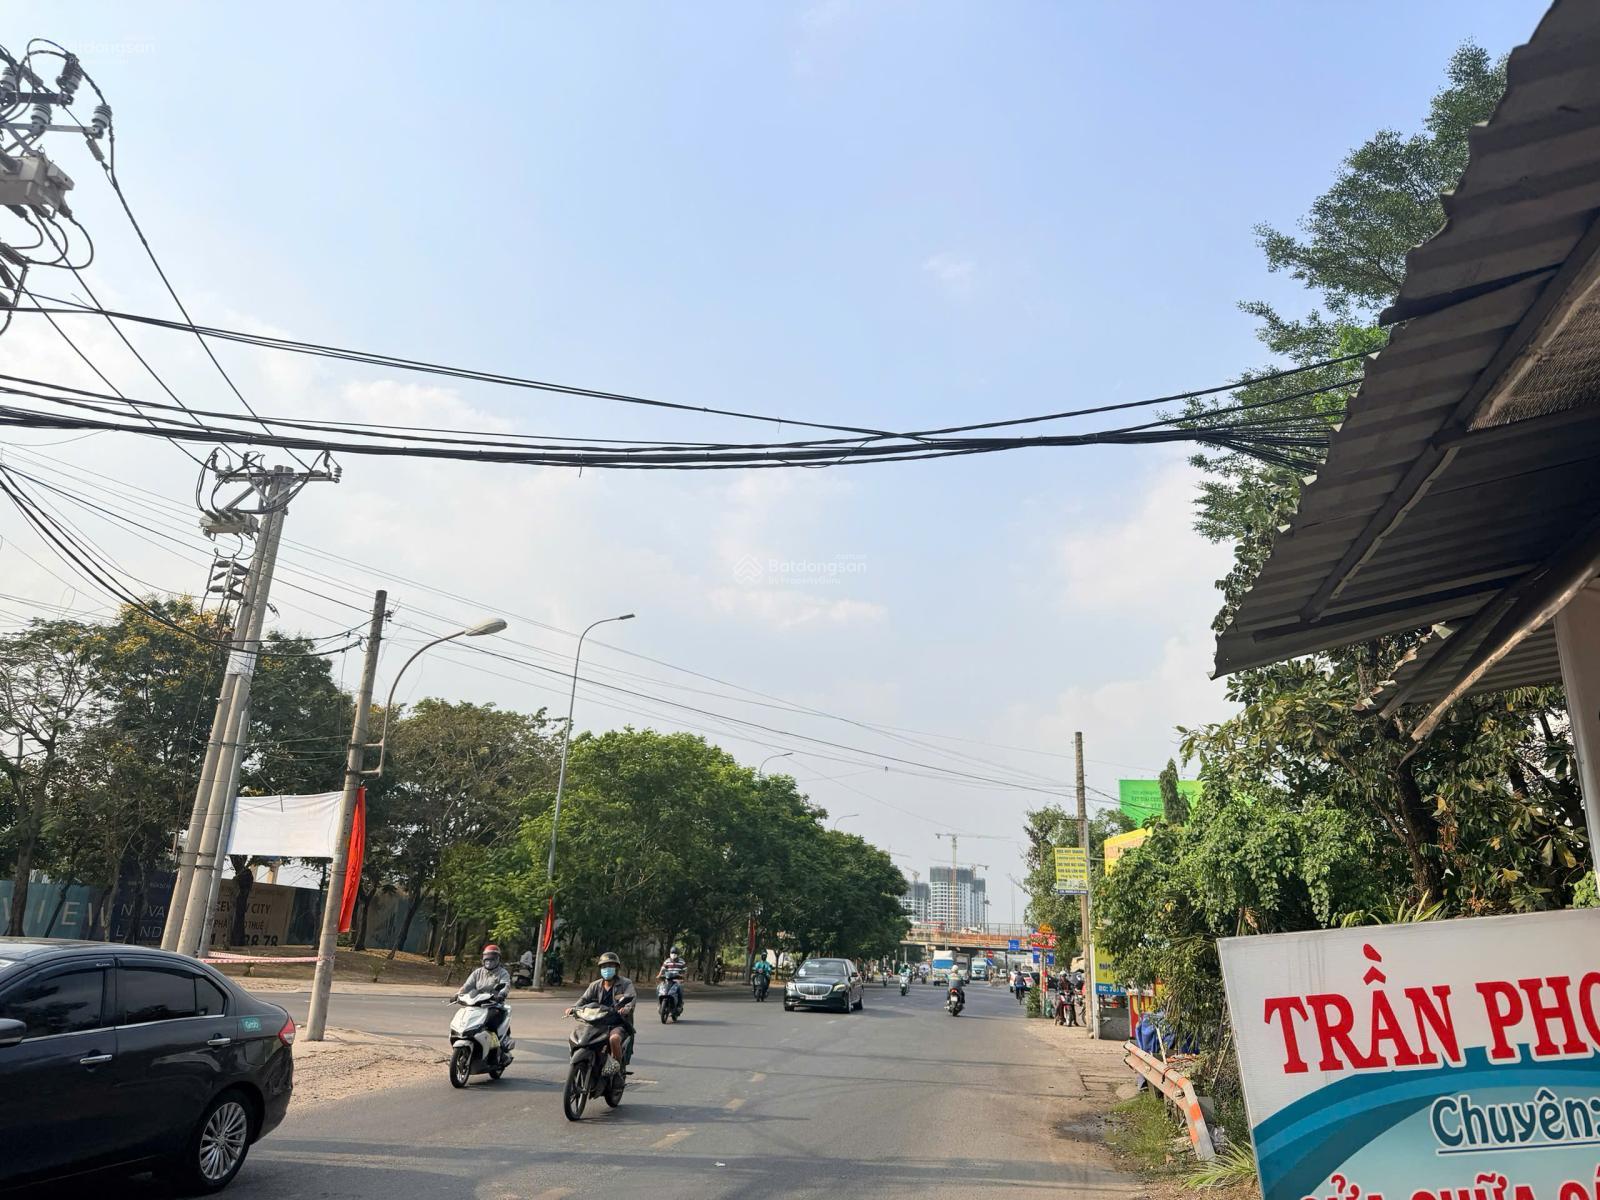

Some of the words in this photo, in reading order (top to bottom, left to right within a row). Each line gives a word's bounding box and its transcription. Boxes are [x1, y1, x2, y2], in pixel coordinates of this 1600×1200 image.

[121, 903, 165, 918] NVA
[116, 924, 162, 938] LND
[1264, 944, 1461, 1074] TRẦN
